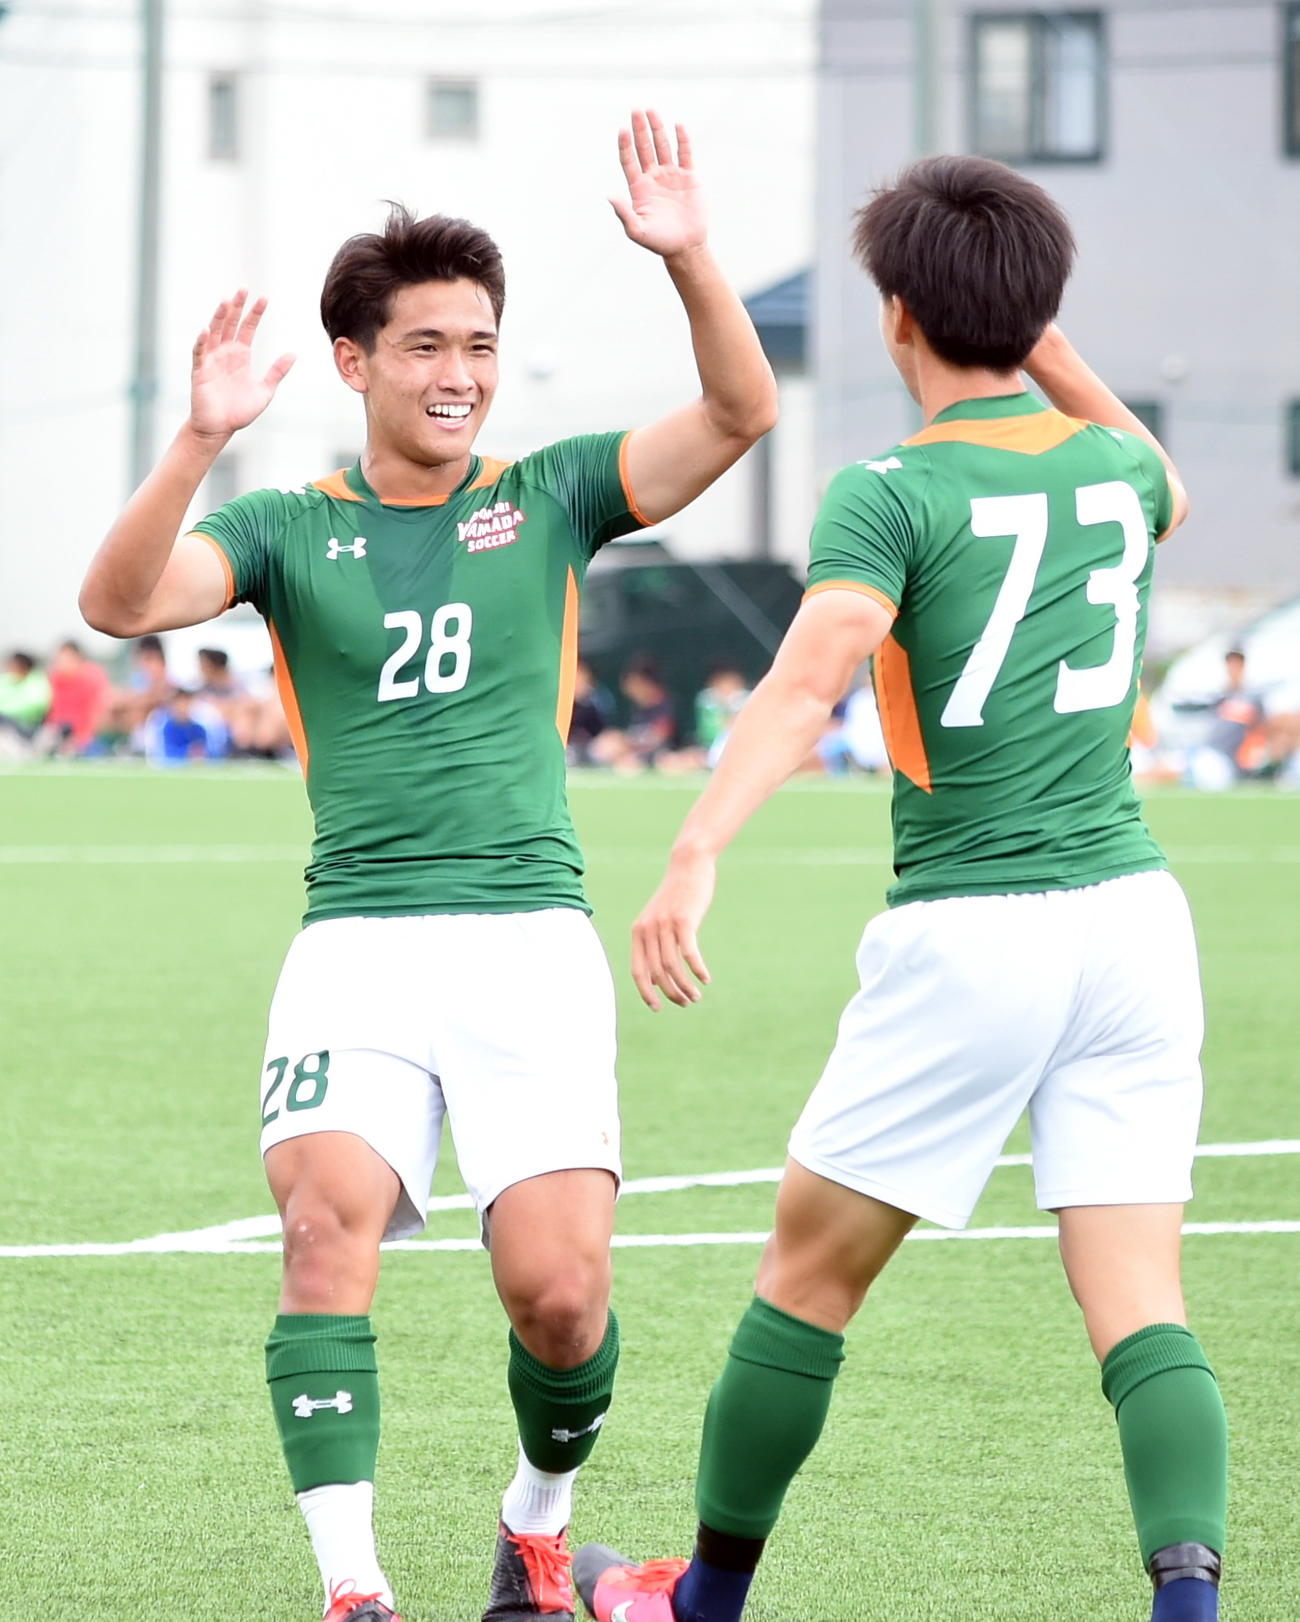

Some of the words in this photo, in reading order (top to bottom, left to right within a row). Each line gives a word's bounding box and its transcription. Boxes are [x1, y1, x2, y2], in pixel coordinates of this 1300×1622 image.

[457, 510, 525, 542] YAMADA
[467, 530, 517, 552] SOCCER
[940, 480, 1149, 728] 73
[377, 602, 473, 702] 28
[261, 1049, 331, 1128] 28
